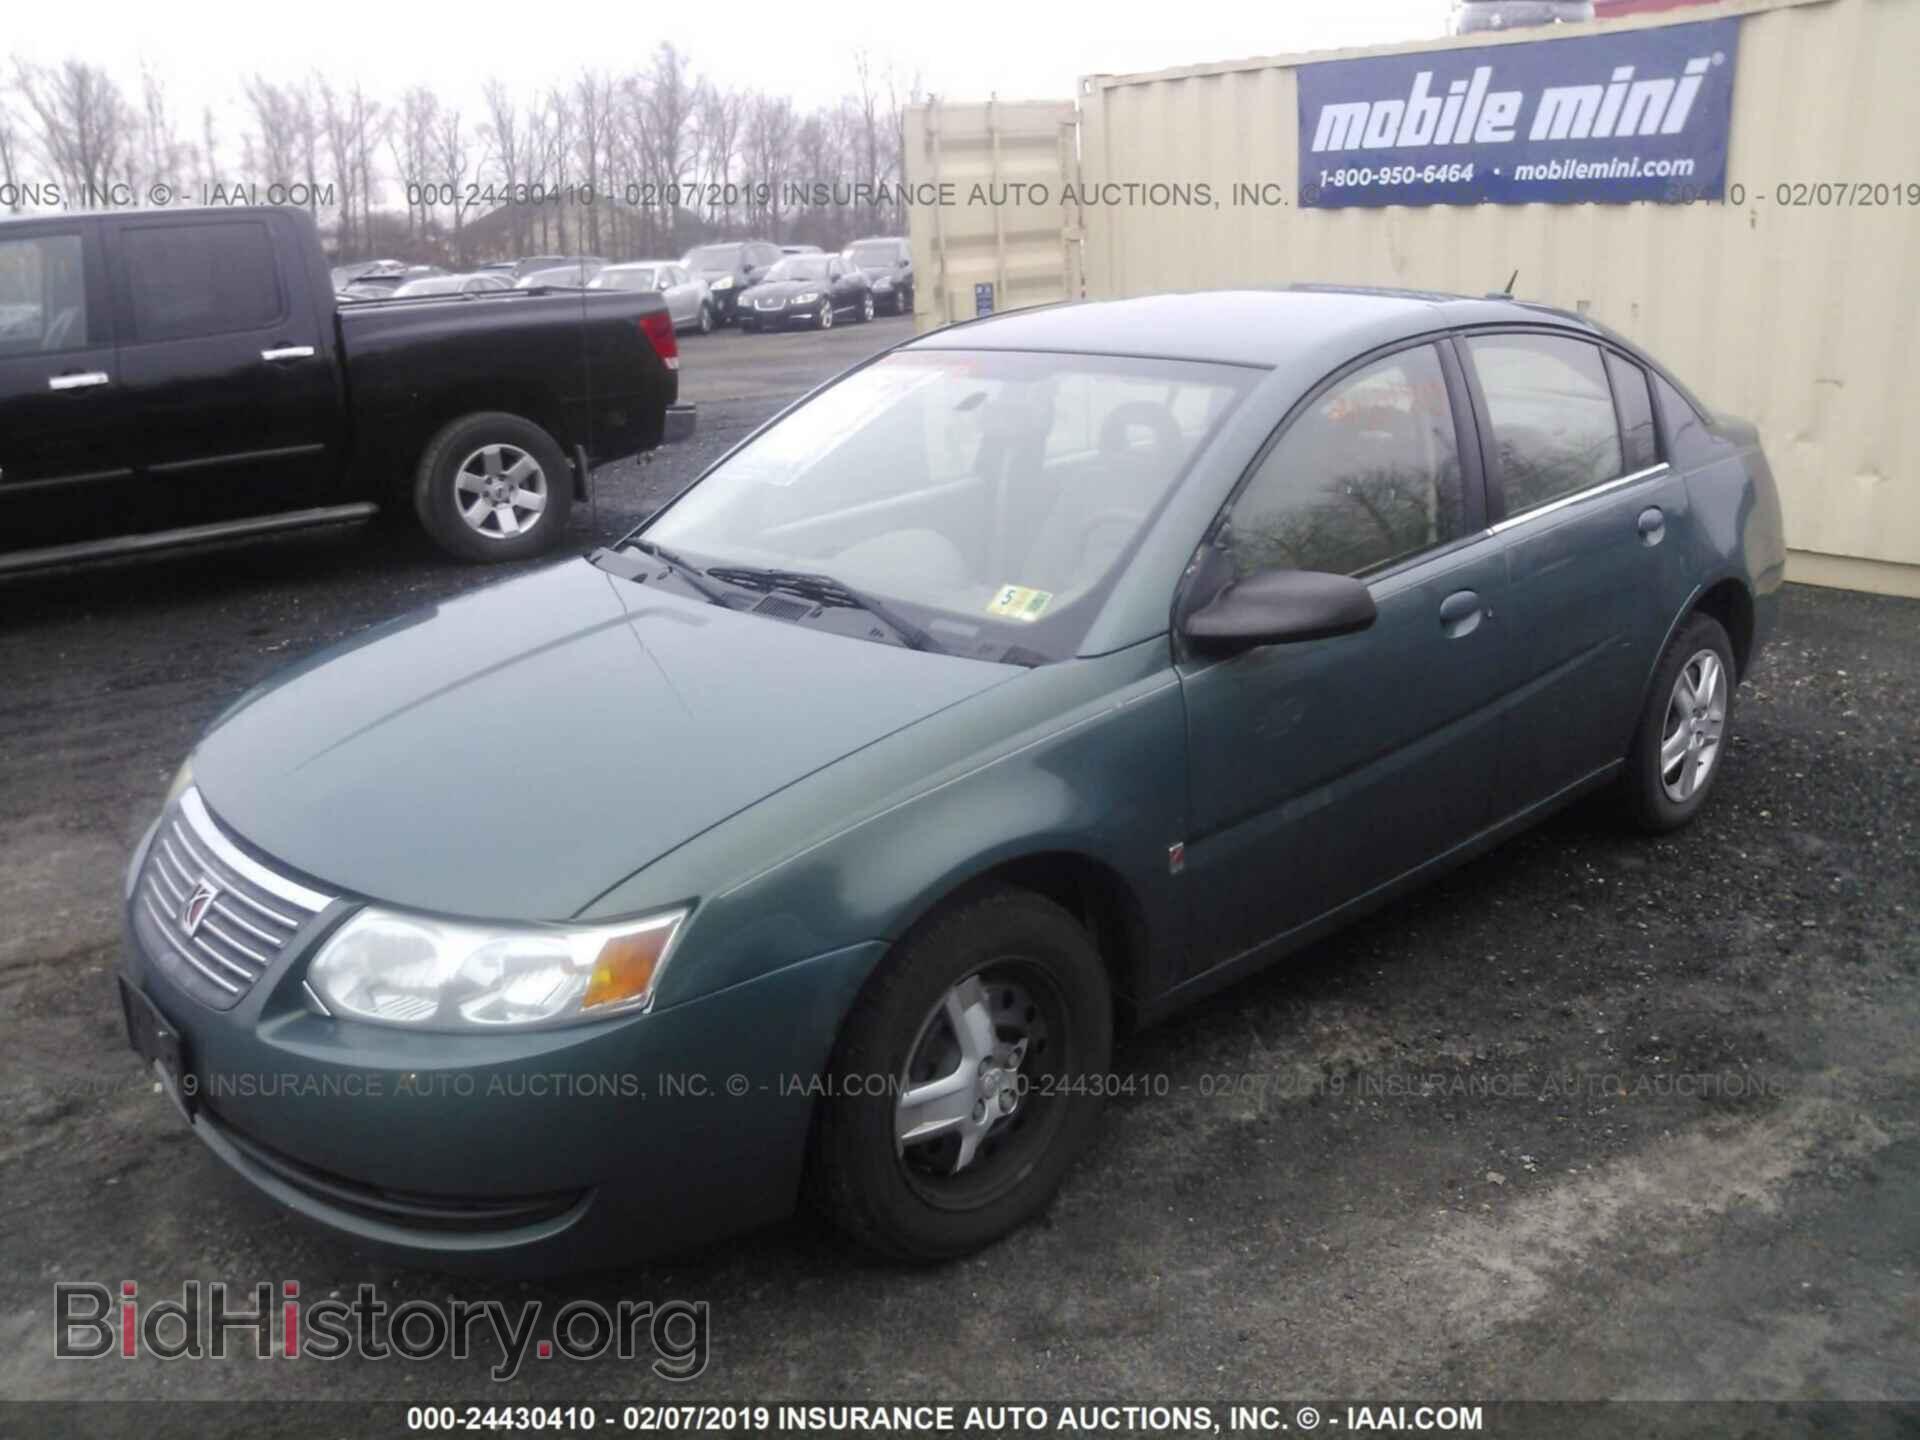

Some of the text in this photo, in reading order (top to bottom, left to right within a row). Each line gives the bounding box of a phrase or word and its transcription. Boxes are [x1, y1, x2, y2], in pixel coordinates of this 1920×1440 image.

[1311, 66, 1523, 152] mobile
[1320, 156, 1695, 188] 1-800-950-6464 mobilemini.com
